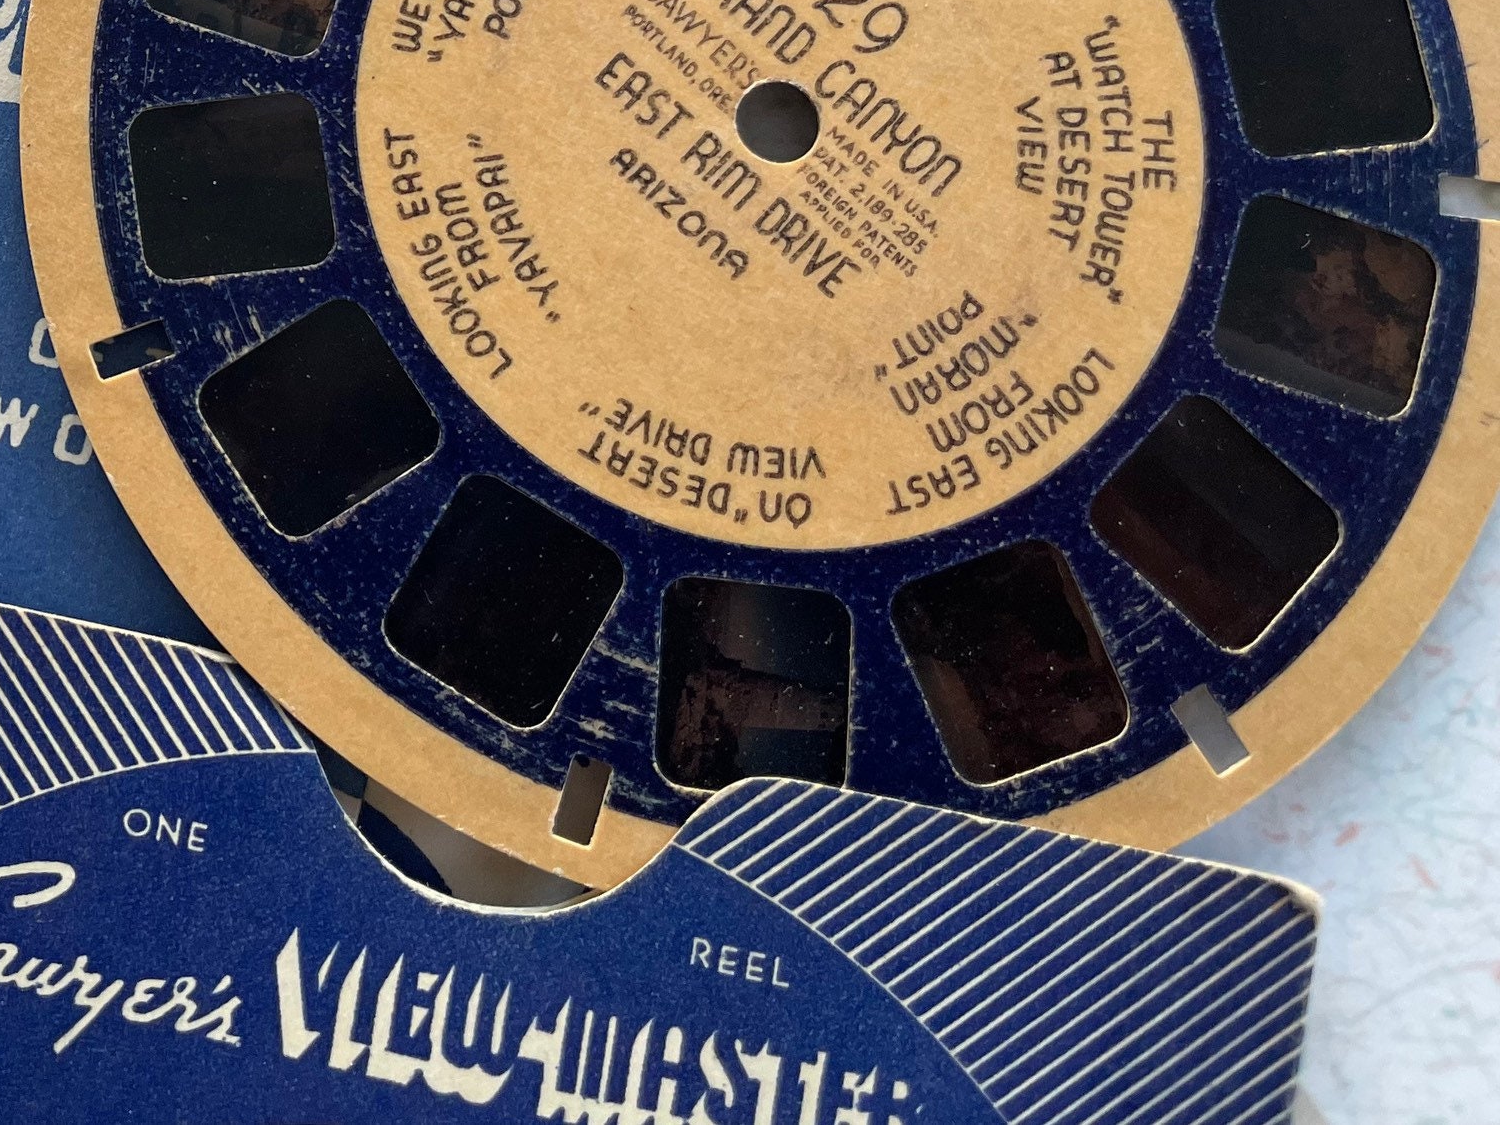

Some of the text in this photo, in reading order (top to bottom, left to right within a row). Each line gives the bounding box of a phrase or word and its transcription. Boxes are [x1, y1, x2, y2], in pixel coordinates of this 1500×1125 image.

[594, 51, 862, 299] EAST RIM DRIVE
[815, 60, 963, 197] CANYON
[825, 125, 880, 177] MADE
[882, 178, 905, 201] IN
[1014, 95, 1049, 195] VIEW
[1043, 51, 1092, 253] AT DESERT
[1142, 110, 1178, 193] THE
[383, 127, 514, 380] LOOKING EAST
[434, 181, 501, 292] FROM
[609, 148, 749, 280] ARIZONA
[796, 162, 918, 278] FOREIGN PATENTS
[799, 190, 852, 239] APPLIED
[726, 441, 827, 480] VIEW
[885, 347, 1116, 515] LOOKING EAST
[925, 370, 1035, 453] FROM
[758, 490, 812, 529] ON
[123, 809, 208, 852] ONE
[689, 936, 790, 989] REEL
